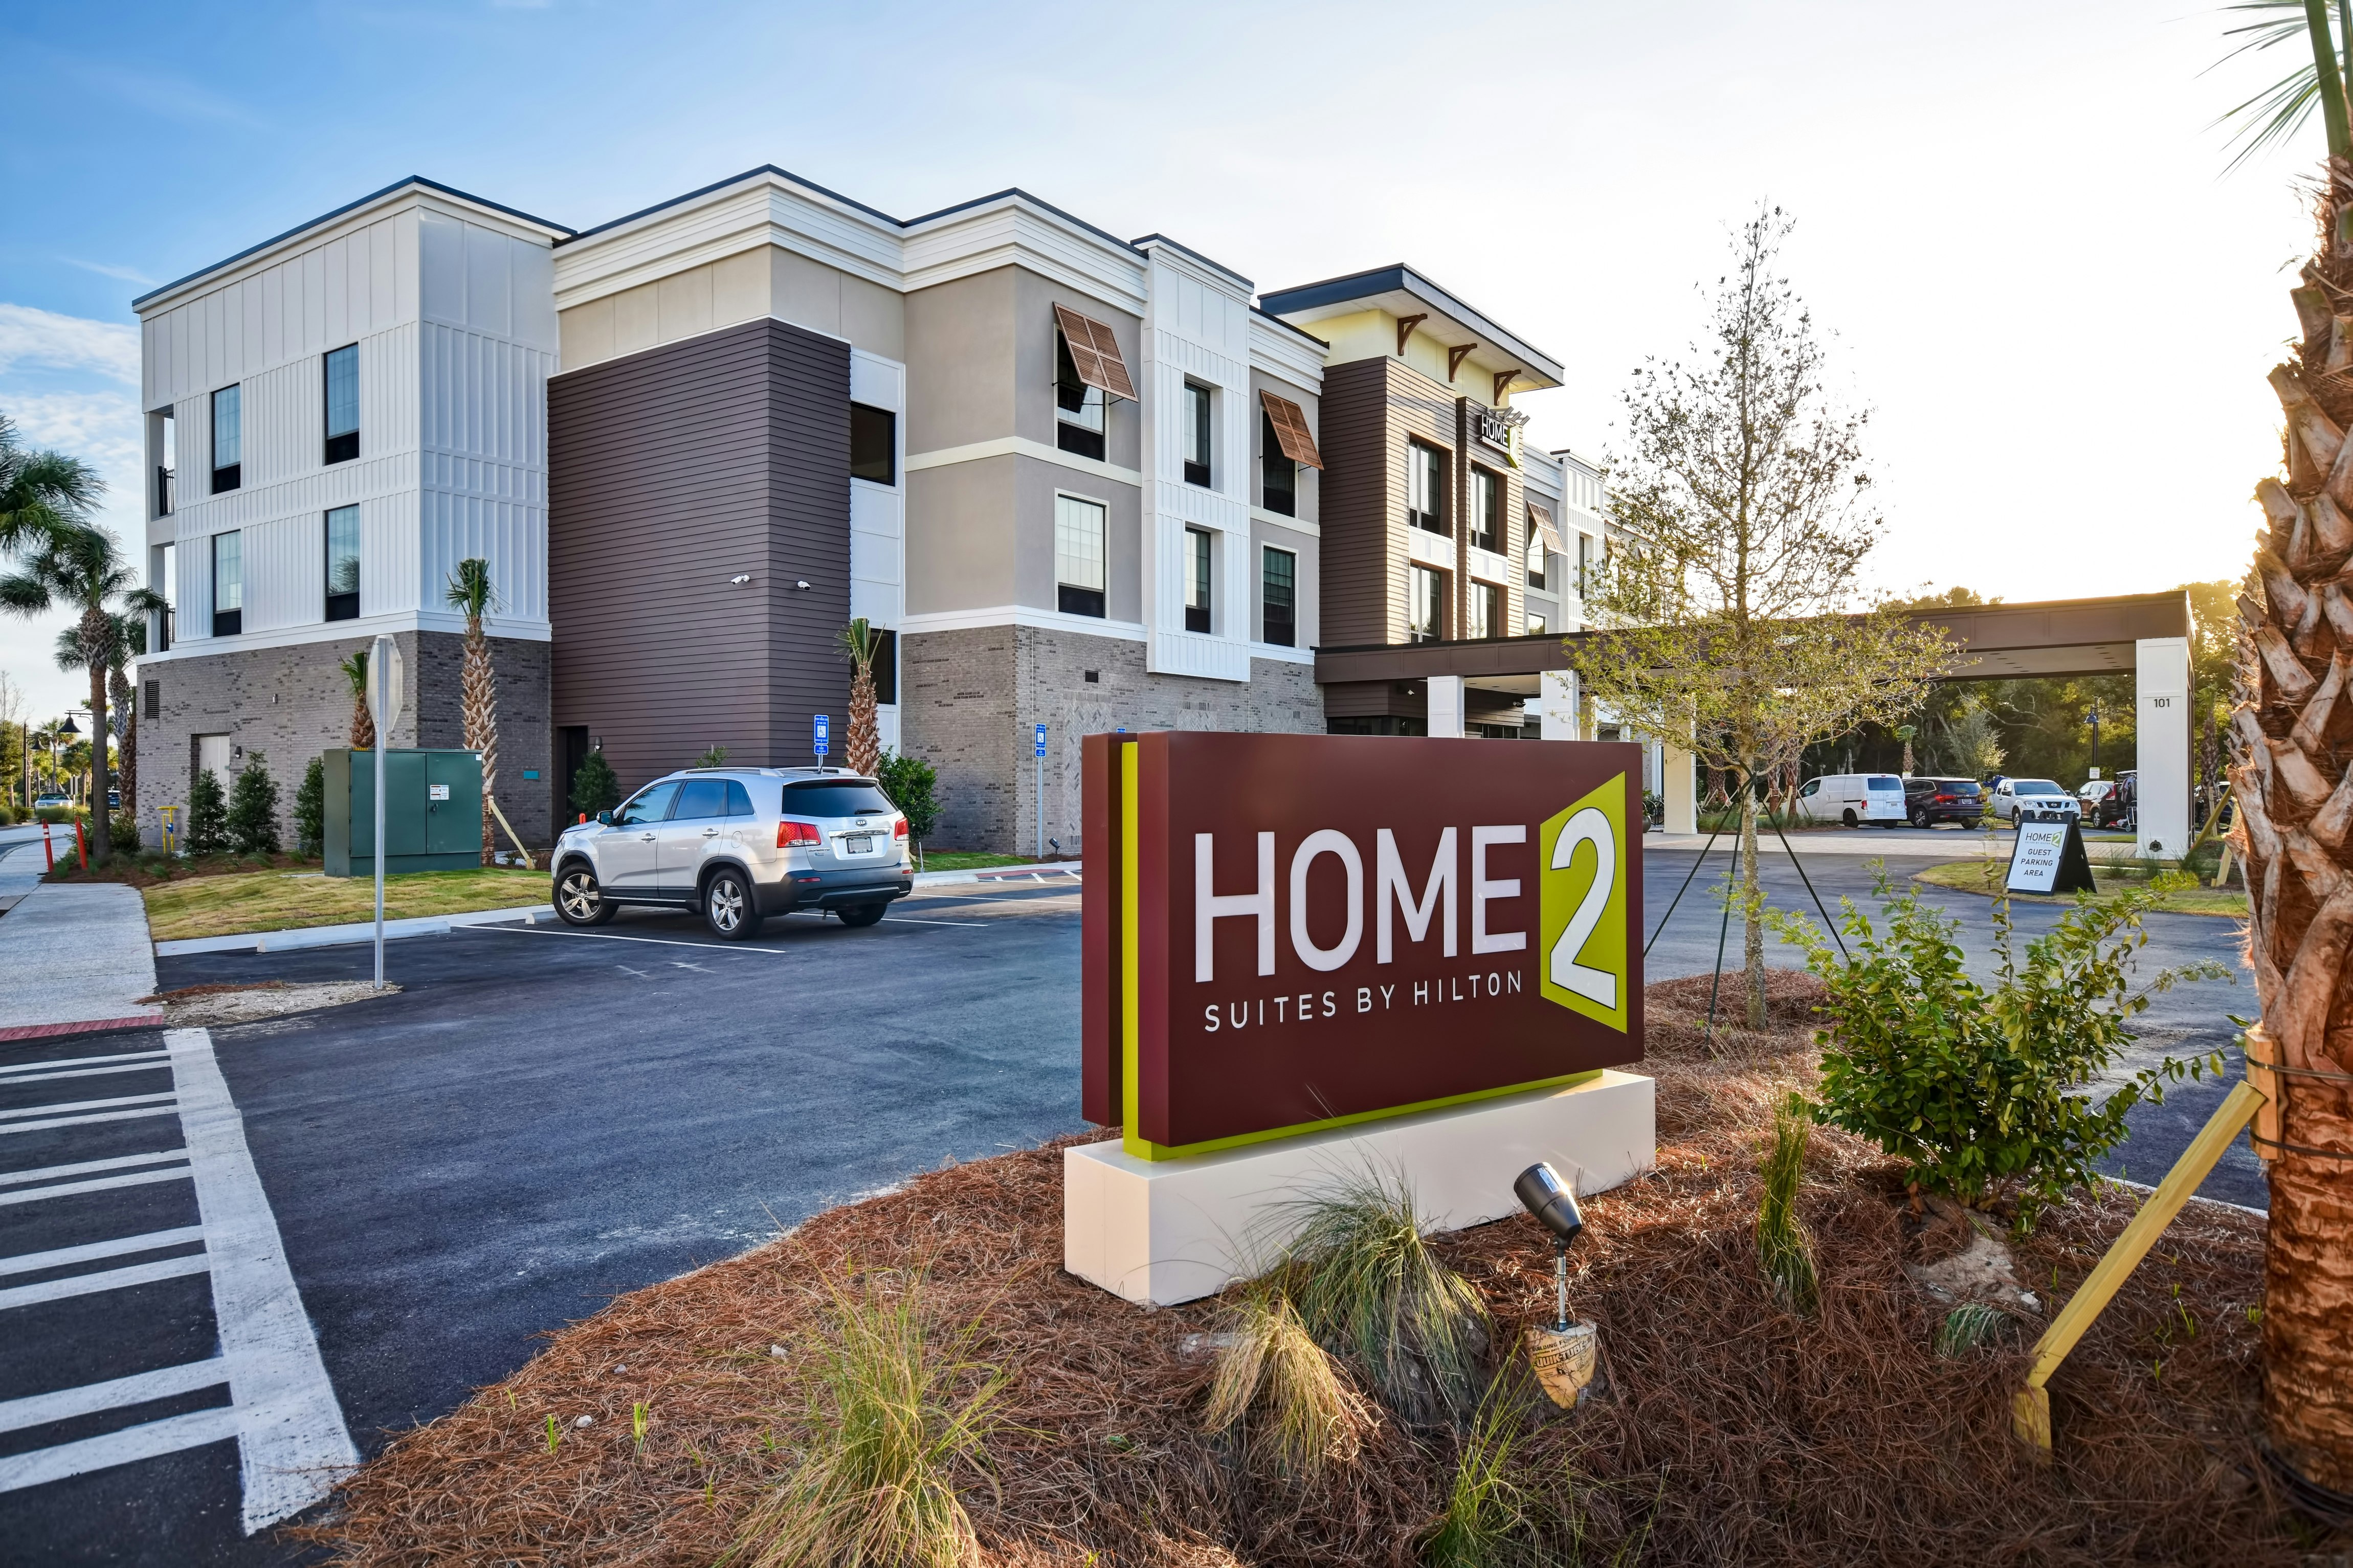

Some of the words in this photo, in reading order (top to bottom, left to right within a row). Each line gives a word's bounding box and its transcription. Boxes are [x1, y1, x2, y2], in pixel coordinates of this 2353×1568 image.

[2154, 698, 2170, 708] 101
[2021, 858, 2053, 866] PARKING
[1204, 990, 1337, 1033] SUITES
[1357, 983, 1395, 1013] BY
[1413, 970, 1522, 1006] HILTON
[1532, 1342, 1558, 1352] BUILDING
